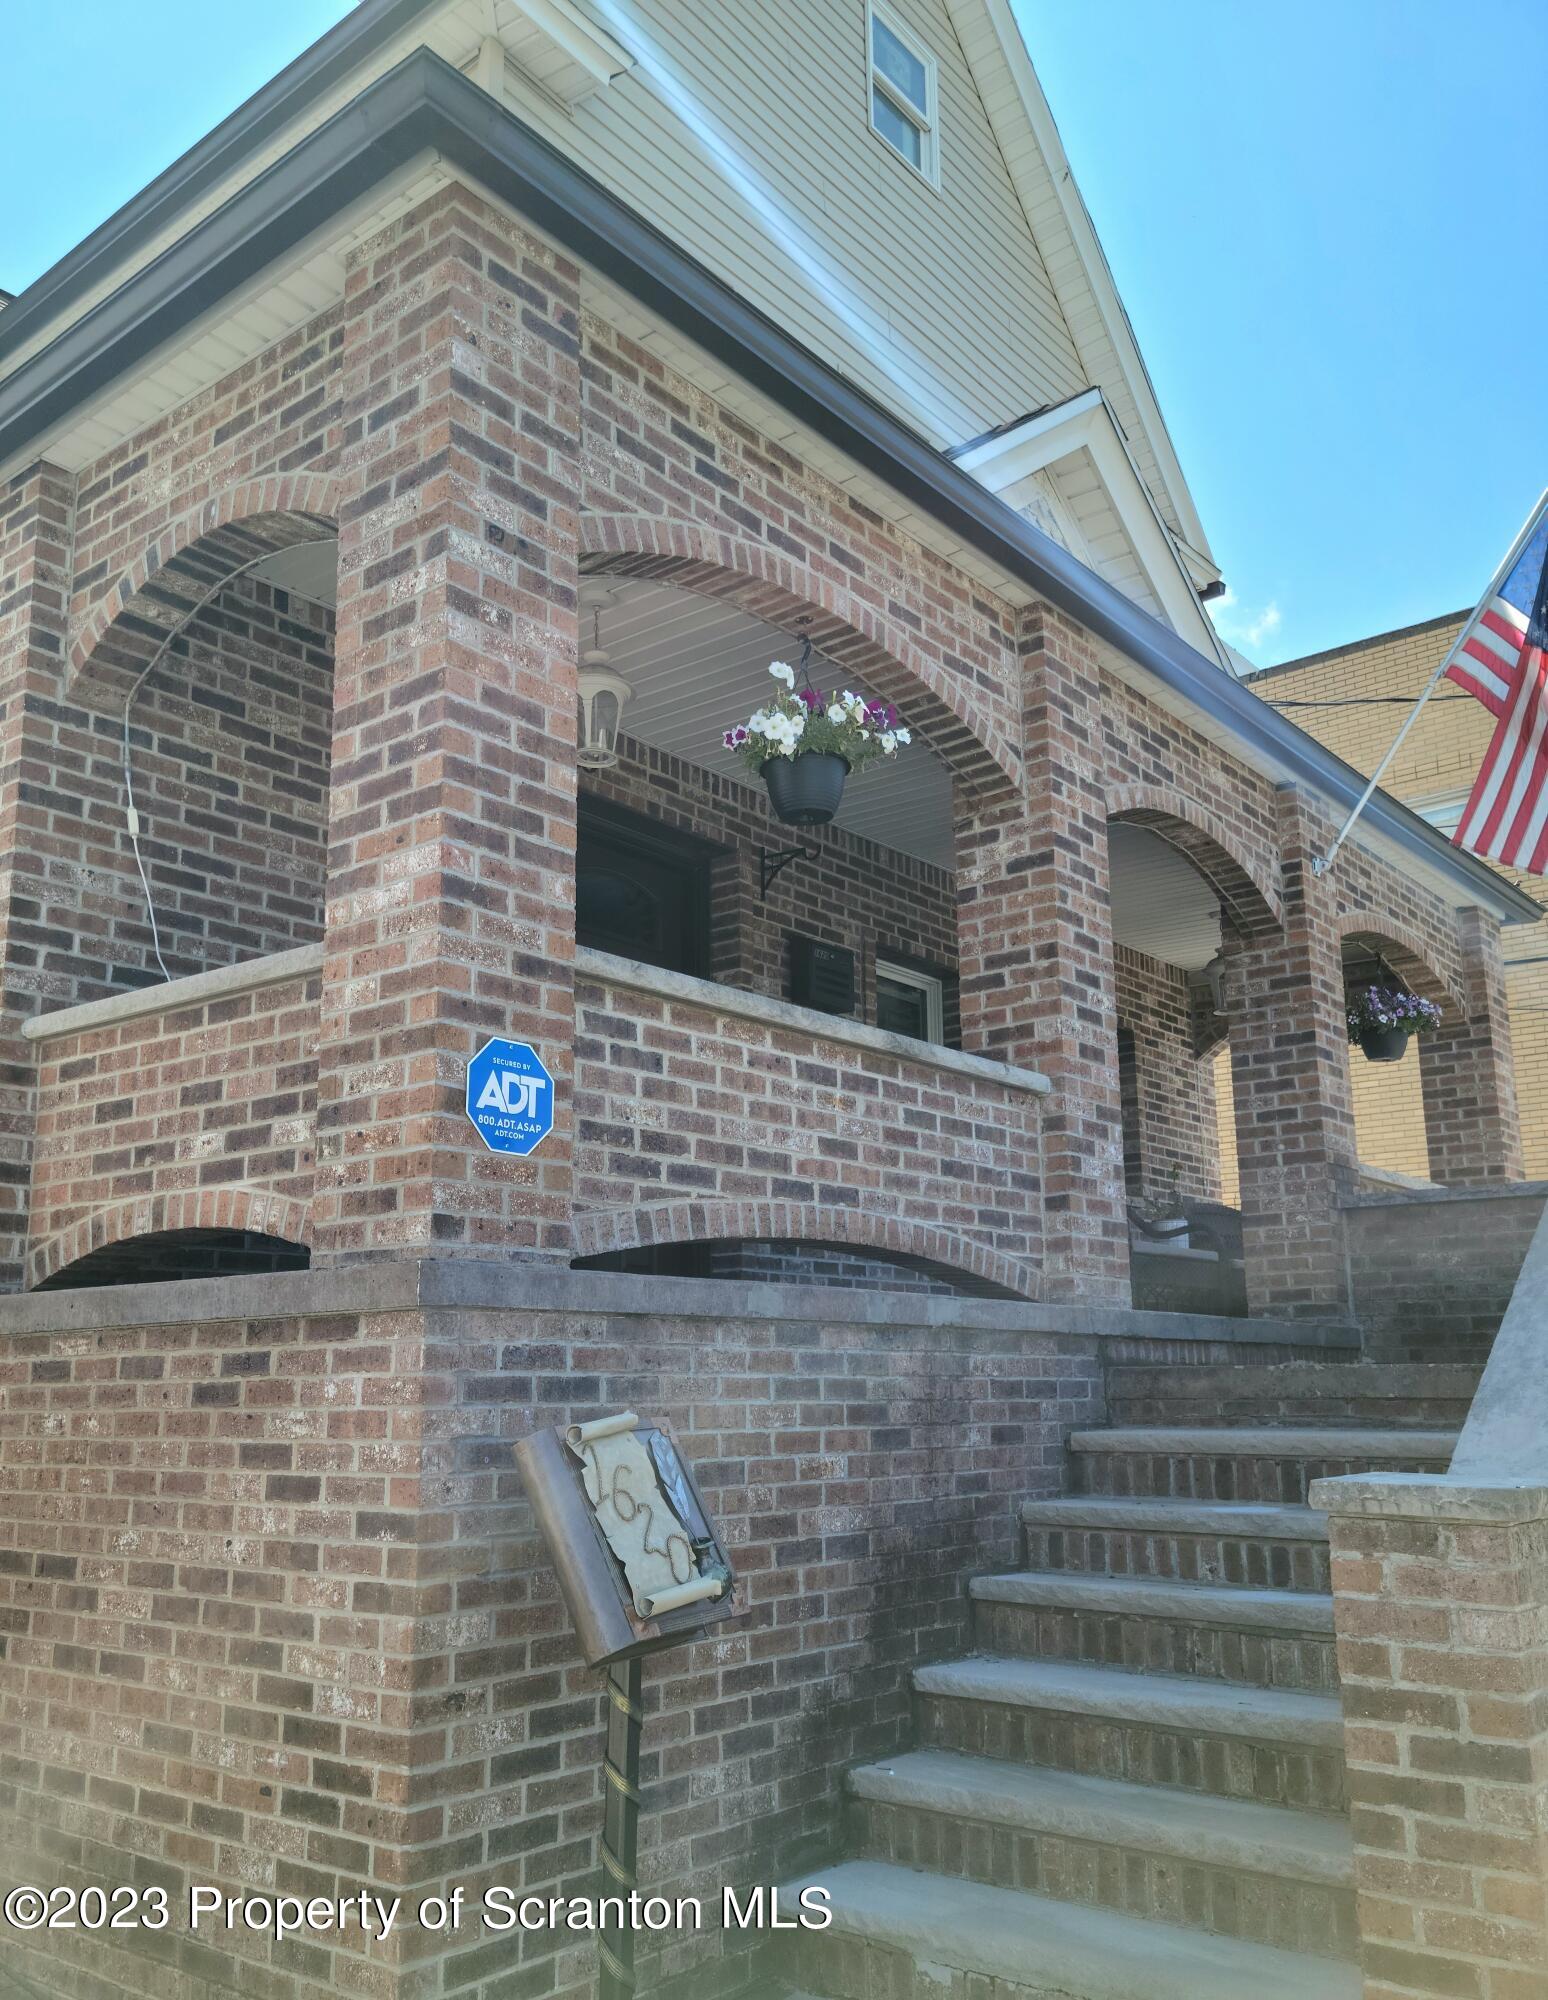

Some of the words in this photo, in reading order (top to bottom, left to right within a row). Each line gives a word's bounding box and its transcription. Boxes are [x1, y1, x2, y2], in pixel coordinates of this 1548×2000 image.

[492, 1057, 521, 1068] SECURED
[522, 1062, 531, 1070] BY
[475, 1069, 545, 1118] ADT
[478, 1114, 542, 1134] 800.ADT.ASAP
[494, 1129, 525, 1140] ADT.COM
